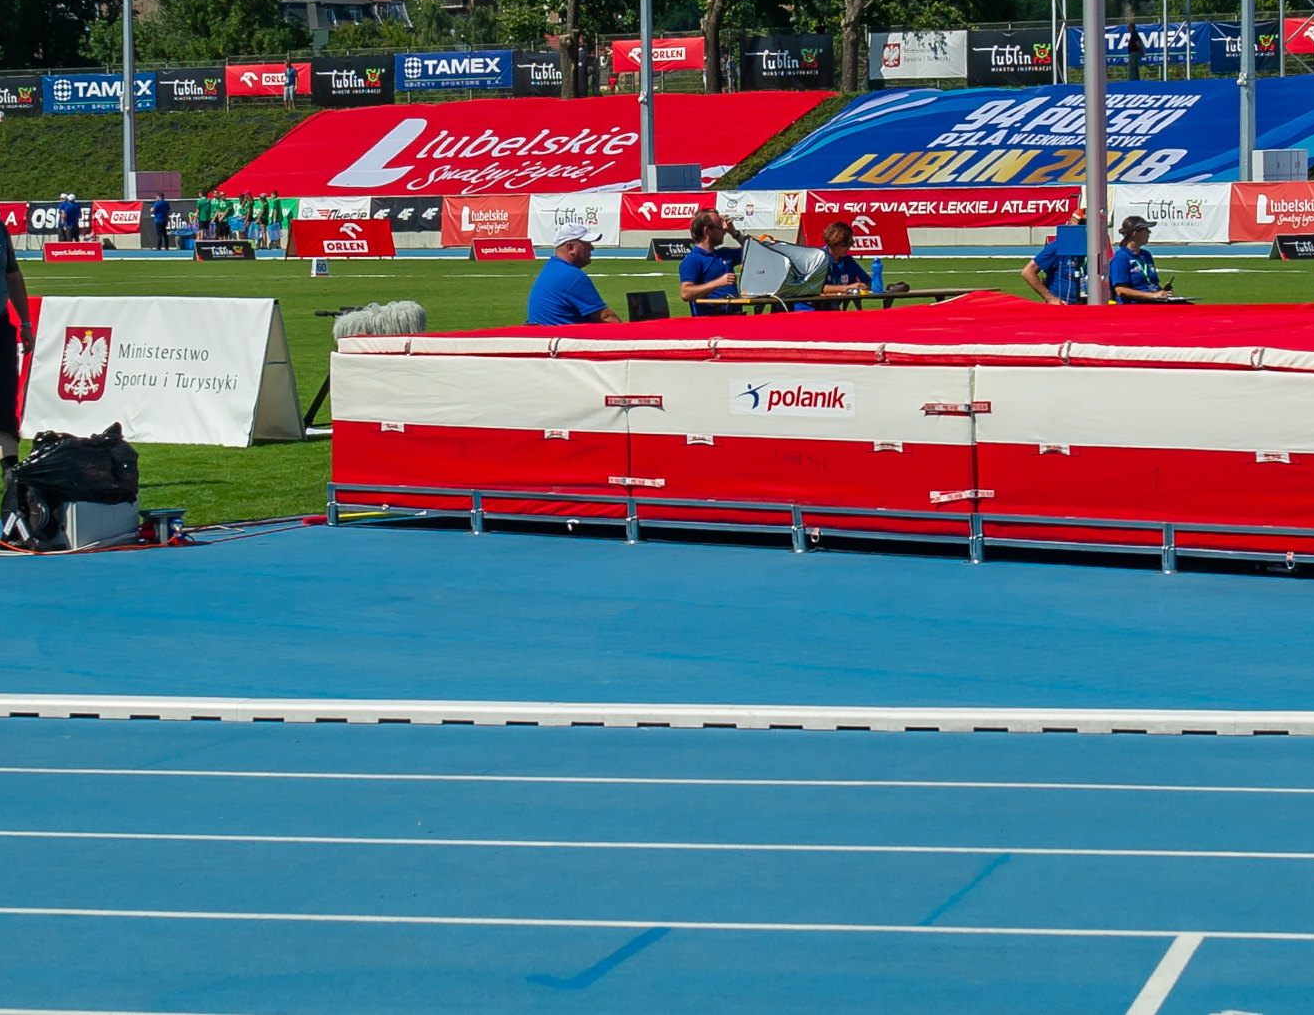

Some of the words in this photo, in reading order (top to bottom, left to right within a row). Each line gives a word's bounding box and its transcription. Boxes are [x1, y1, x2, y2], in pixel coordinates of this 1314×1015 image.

[653, 48, 684, 60] ORLEN
[424, 56, 502, 76] TAMEX
[74, 79, 153, 98] TAMX
[827, 149, 1045, 184] LUBLIN
[663, 205, 697, 217] ORLEN
[938, 200, 997, 215] LEKKIEJ
[1000, 199, 1069, 214] ATLETYKI
[113, 212, 138, 222] ORLEN
[374, 208, 390, 220] 4F
[397, 208, 414, 221] 4F
[421, 207, 439, 221] 4F
[326, 242, 365, 252] ORLEN
[480, 247, 527, 255] sport.lublin.eu
[316, 262, 327, 272] 60
[118, 343, 210, 362] Ministerstwo
[114, 371, 157, 391] Sportu
[163, 372, 168, 387] i
[175, 372, 239, 394] Turystyki
[767, 384, 846, 412] polanik
